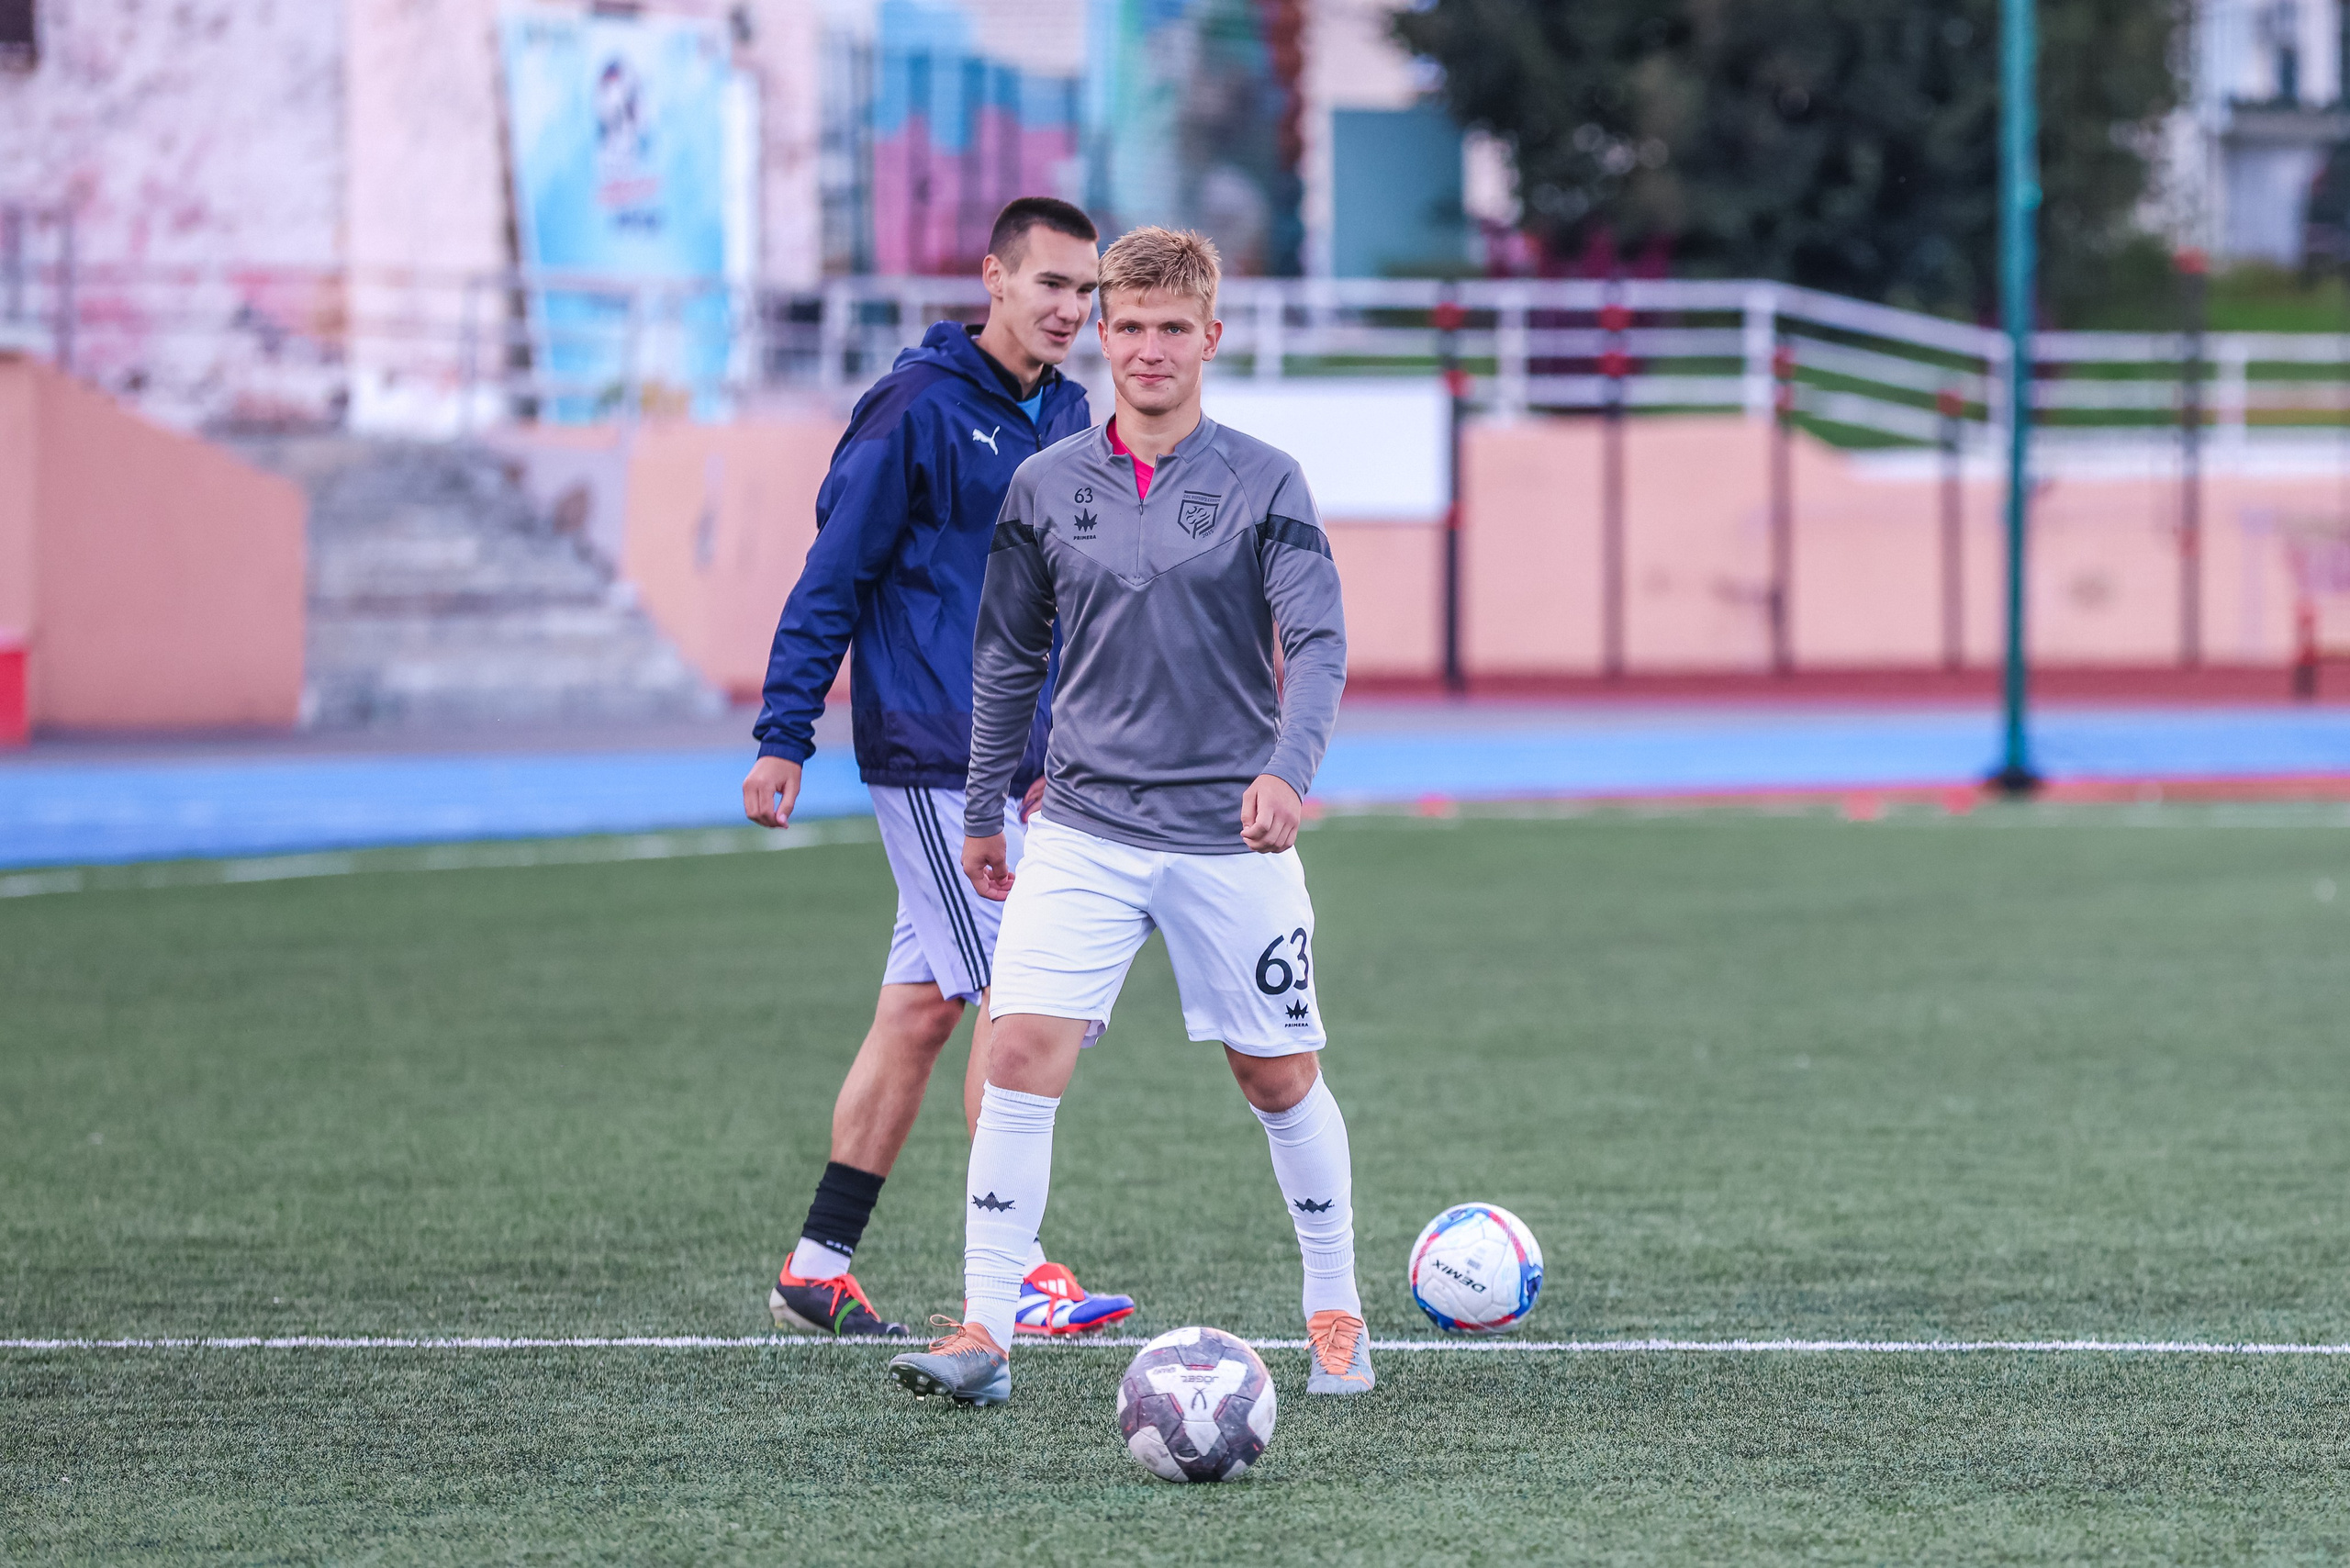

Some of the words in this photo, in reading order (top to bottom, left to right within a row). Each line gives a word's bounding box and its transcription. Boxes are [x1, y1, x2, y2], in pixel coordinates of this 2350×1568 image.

[1074, 487, 1093, 504] 63
[1202, 530, 1214, 539] 2015
[1255, 927, 1310, 996] 63
[1432, 1260, 1487, 1294] DEMIX
